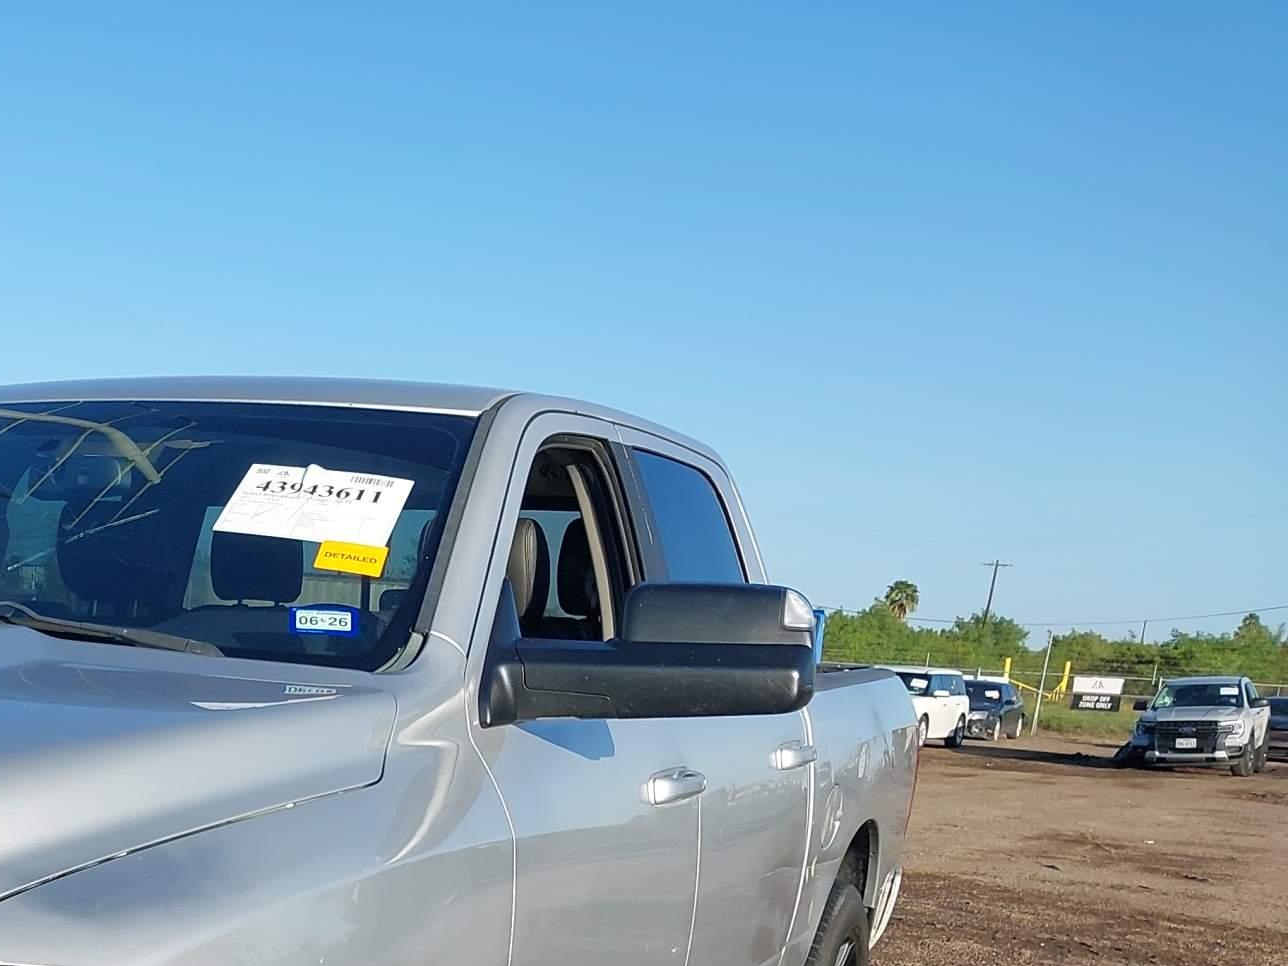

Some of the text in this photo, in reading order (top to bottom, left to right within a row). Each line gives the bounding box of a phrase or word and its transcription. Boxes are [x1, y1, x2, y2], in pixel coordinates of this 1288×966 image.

[256, 480, 383, 504] 43943611
[324, 551, 377, 564] DETAILED
[299, 615, 348, 627] 06 26
[1078, 701, 1096, 709] ZONE
